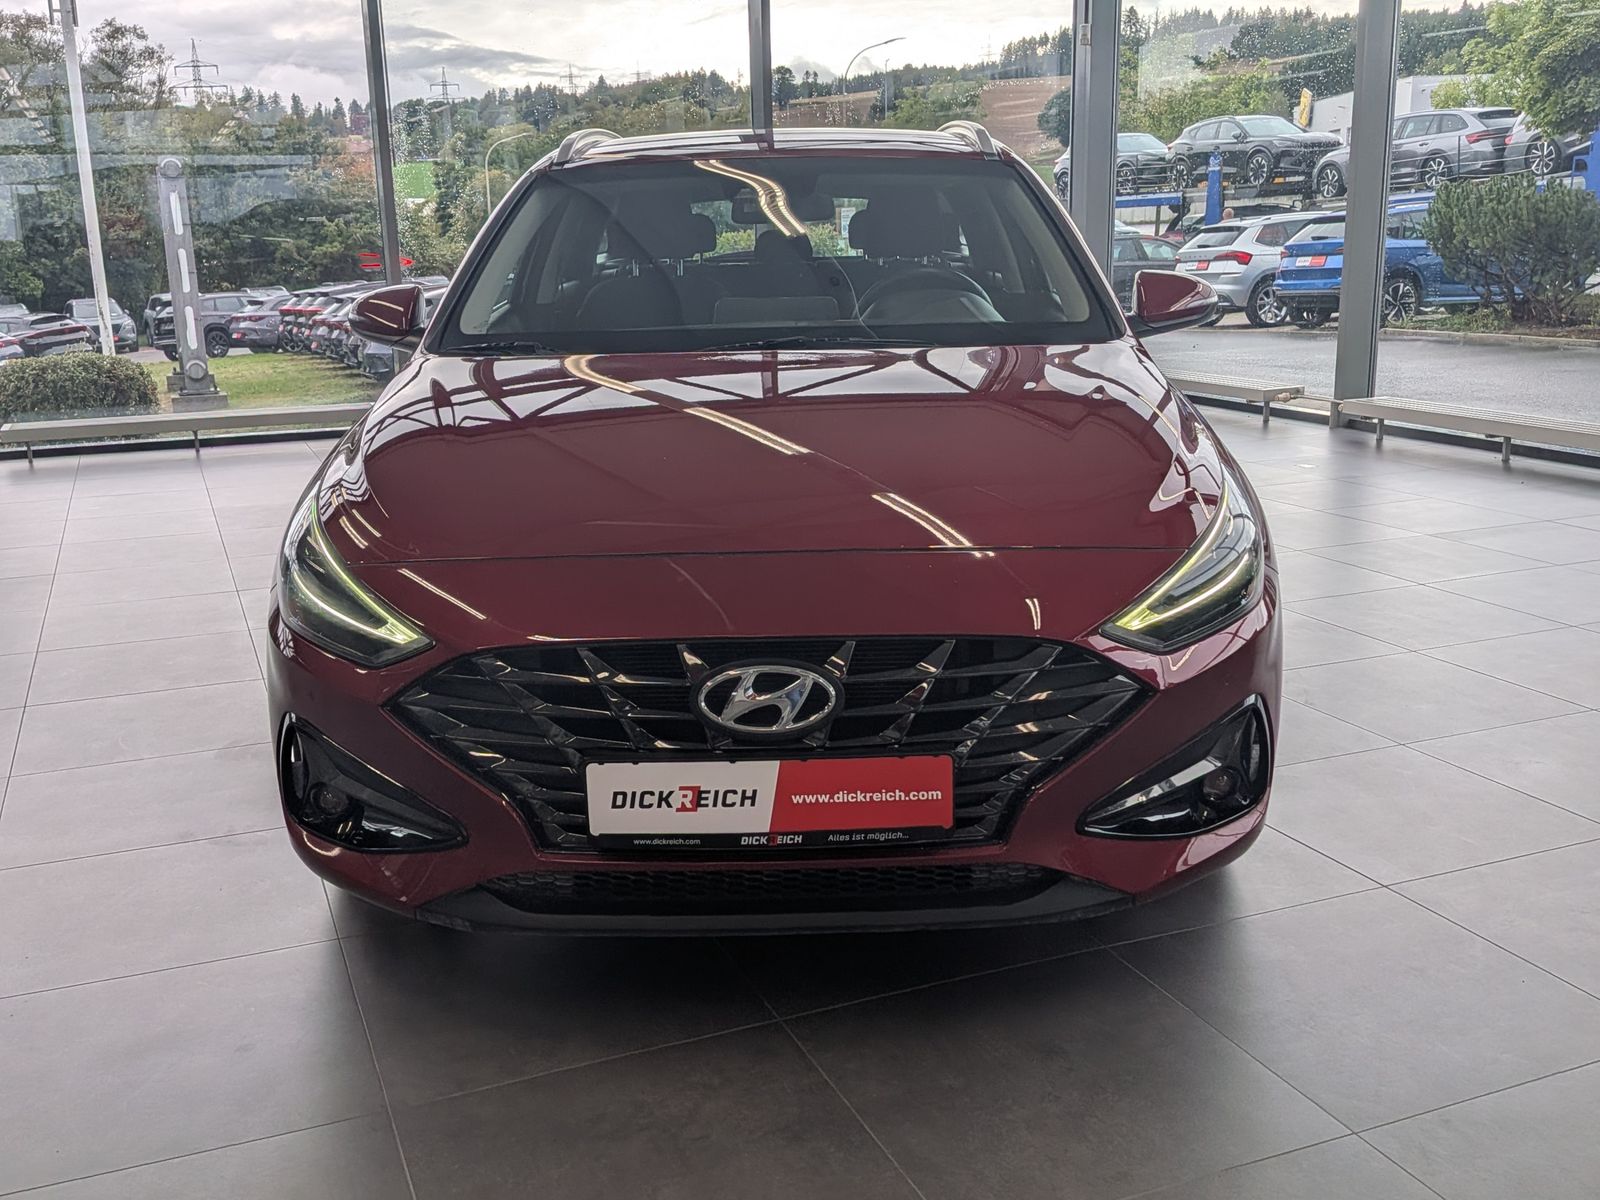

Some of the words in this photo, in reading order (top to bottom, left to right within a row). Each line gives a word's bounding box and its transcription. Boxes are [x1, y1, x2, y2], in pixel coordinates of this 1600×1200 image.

[611, 786, 758, 812] DICKREICH
[791, 788, 942, 804] www.dickreich.com
[633, 838, 701, 846] www.dickreich.com
[827, 833, 850, 842] Alles
[852, 833, 865, 841] ist
